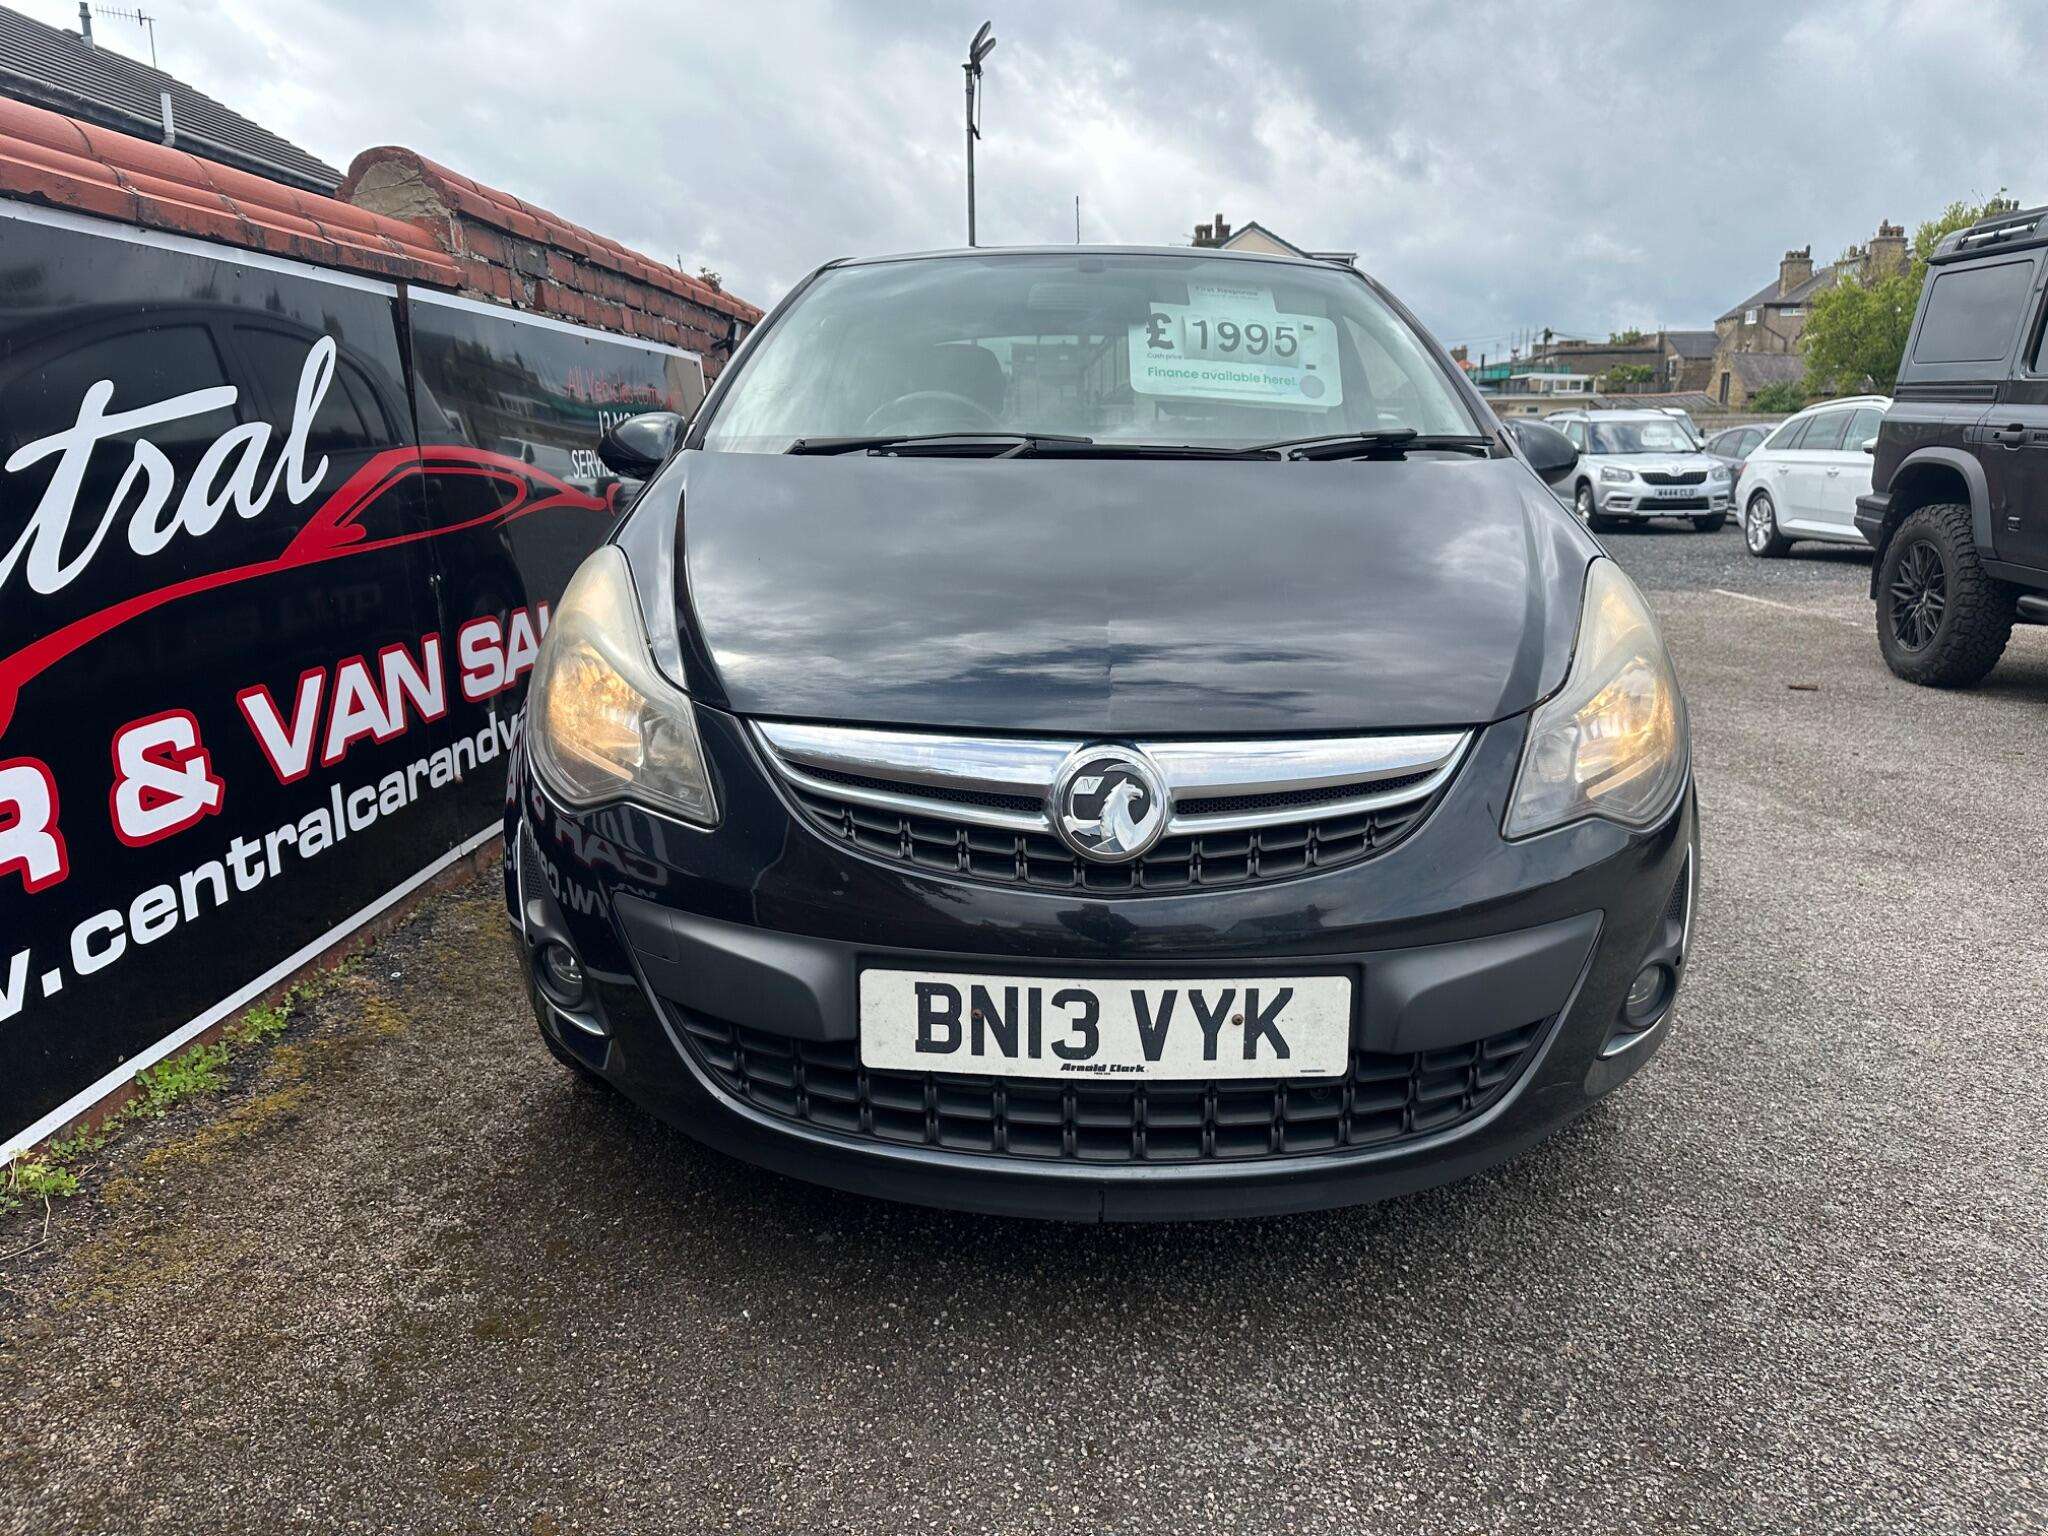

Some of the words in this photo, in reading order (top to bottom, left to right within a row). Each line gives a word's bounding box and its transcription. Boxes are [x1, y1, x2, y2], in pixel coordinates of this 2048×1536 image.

[1147, 366, 1199, 380] Finance
[1201, 370, 1261, 384] available
[110, 708, 224, 846] &
[236, 632, 447, 785] VAN
[915, 982, 1099, 1060] BN13
[1130, 986, 1294, 1061] VYK
[1060, 1063, 1107, 1072] Arnold
[1109, 1064, 1145, 1073] Clark
